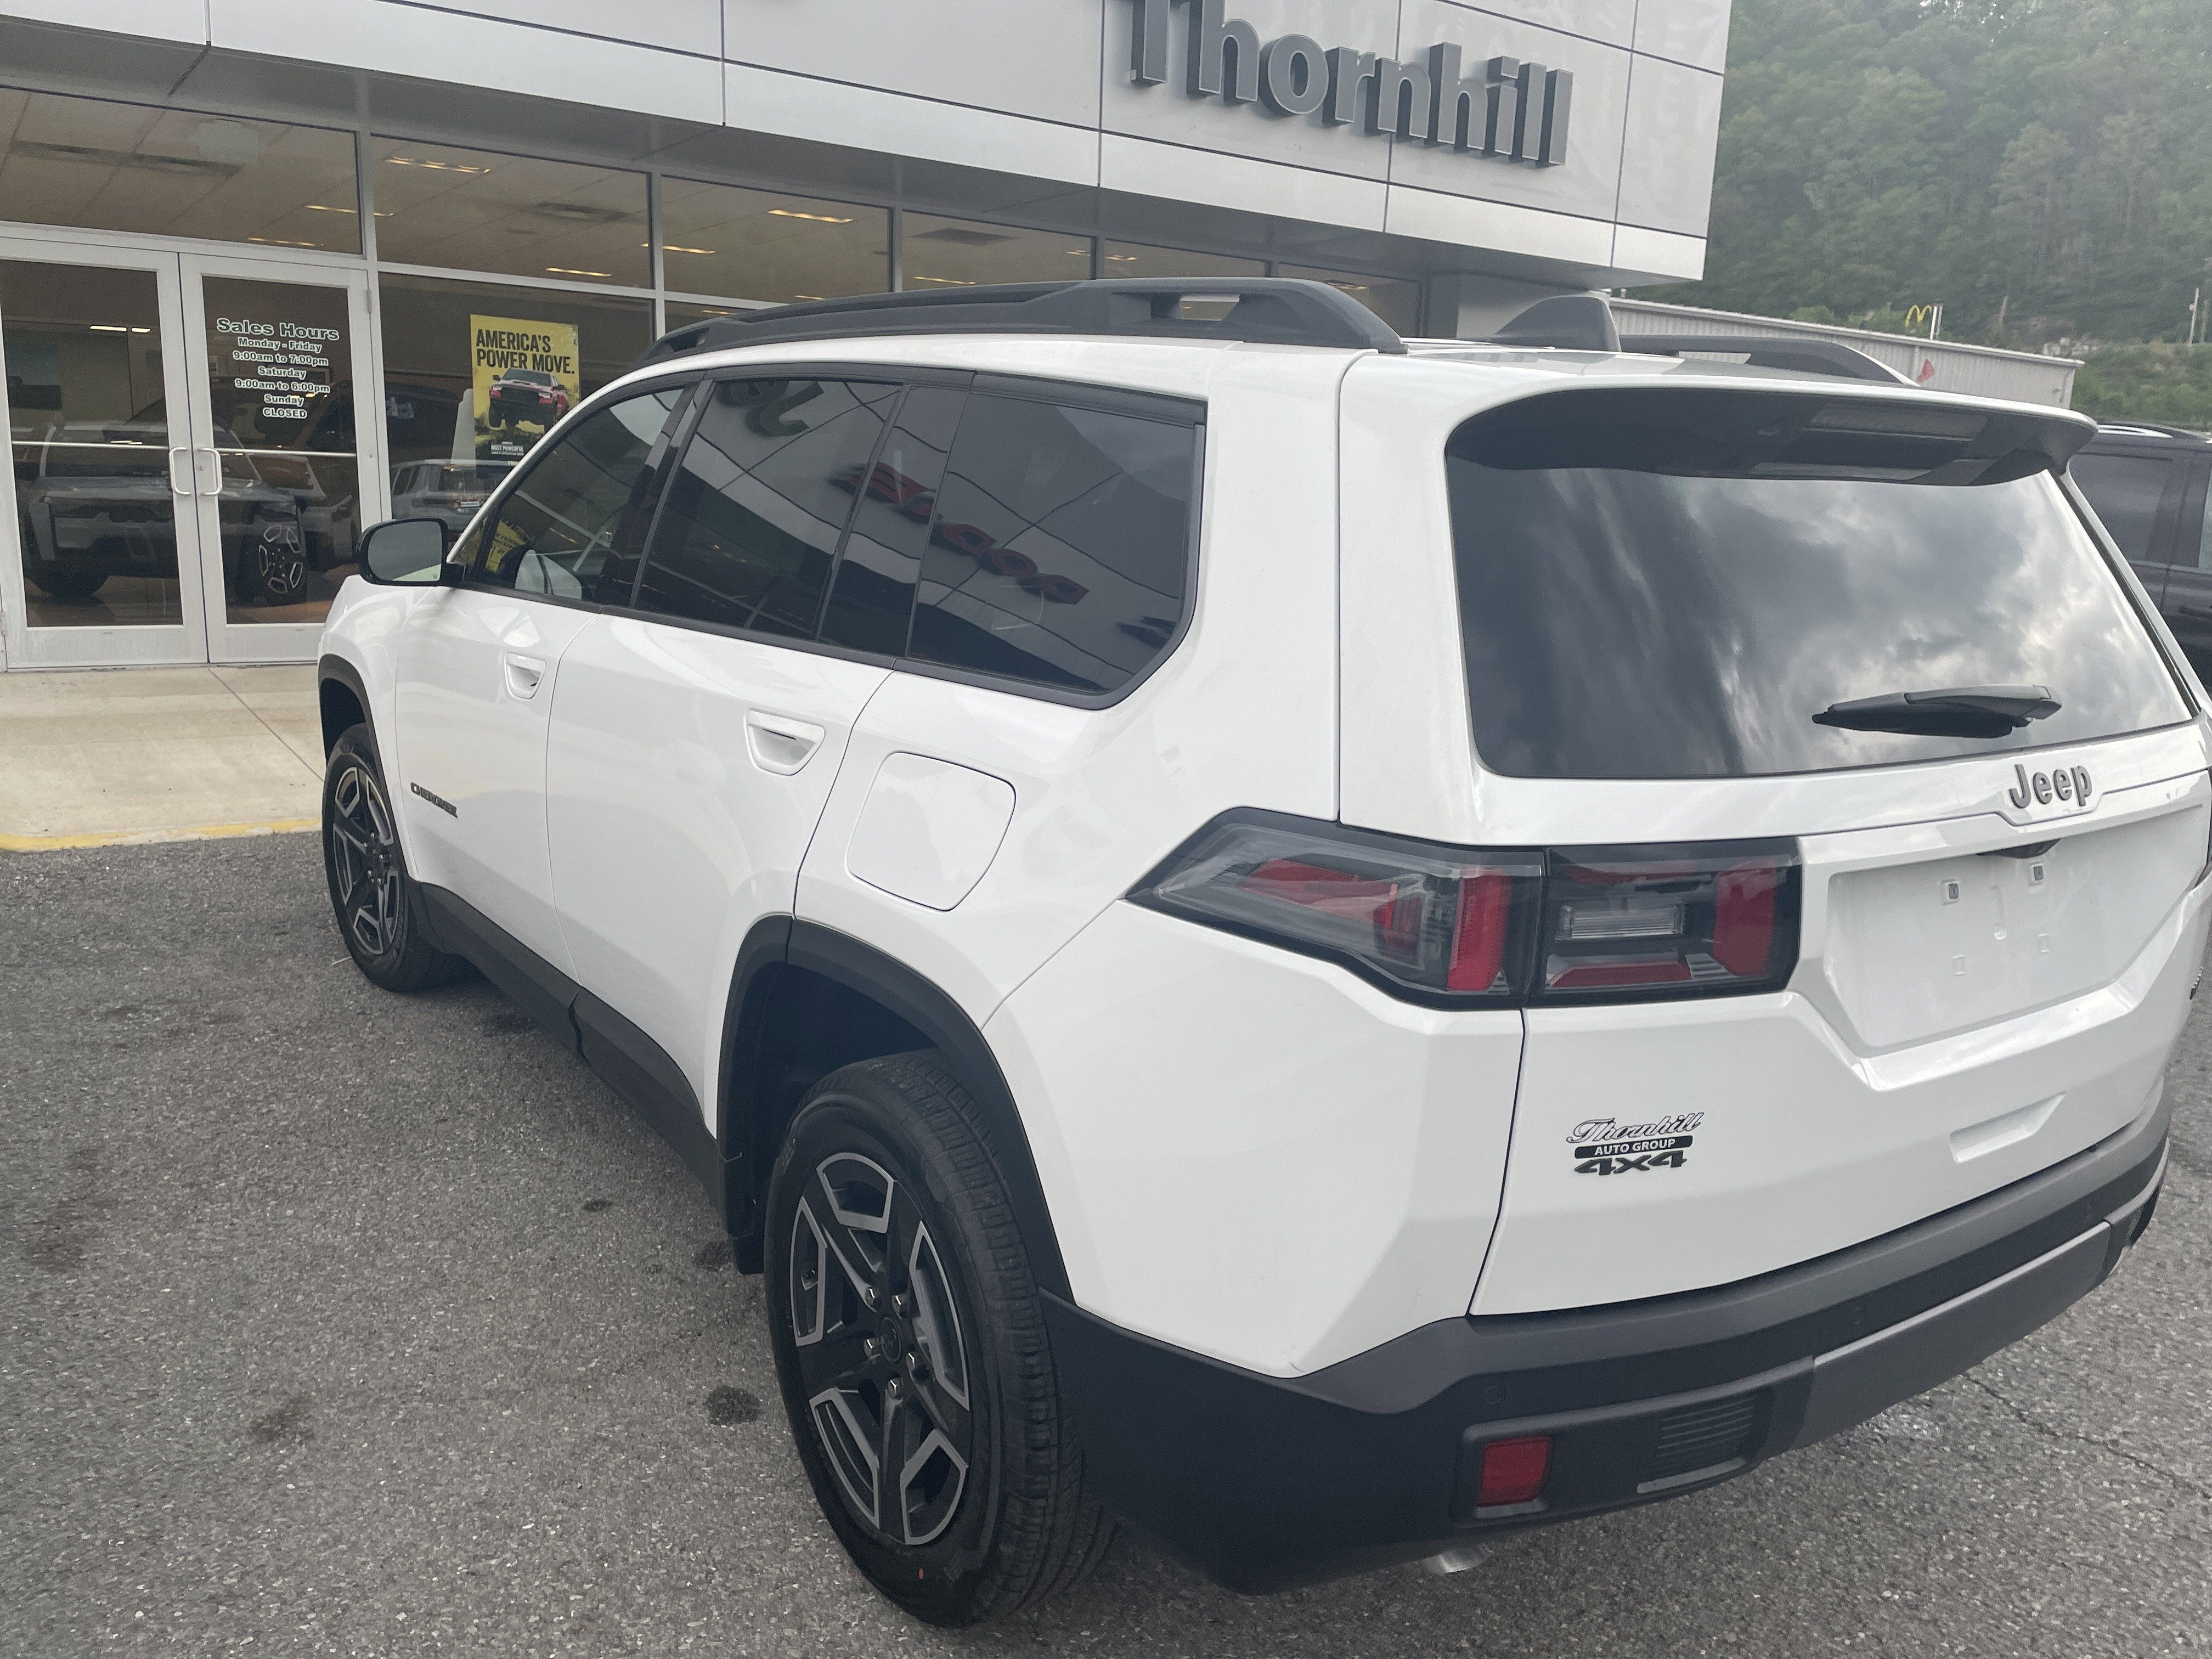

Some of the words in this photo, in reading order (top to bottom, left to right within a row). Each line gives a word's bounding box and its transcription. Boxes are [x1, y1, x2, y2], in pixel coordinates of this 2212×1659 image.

[217, 318, 274, 335] Sales
[279, 322, 340, 340] Hours
[238, 336, 280, 351] Monday
[289, 340, 322, 353] Friday
[476, 329, 551, 353] AMERICA'S
[233, 350, 273, 362] 9:00am
[275, 353, 287, 363] to
[289, 354, 329, 366] 7:00pm
[477, 348, 527, 369] POWER
[532, 354, 574, 374] MOVE.
[258, 365, 306, 380] Saturday
[235, 378, 275, 390] 9:00am
[277, 381, 289, 391] to
[291, 382, 330, 394] 6:00pm
[264, 393, 304, 407] Sunday
[263, 407, 307, 419] CLOSED
[2009, 764, 2092, 809] Jeep
[1566, 1112, 1705, 1143] Thornhill
[1594, 1143, 1629, 1156] AUTO
[1632, 1138, 1676, 1152] GROUP
